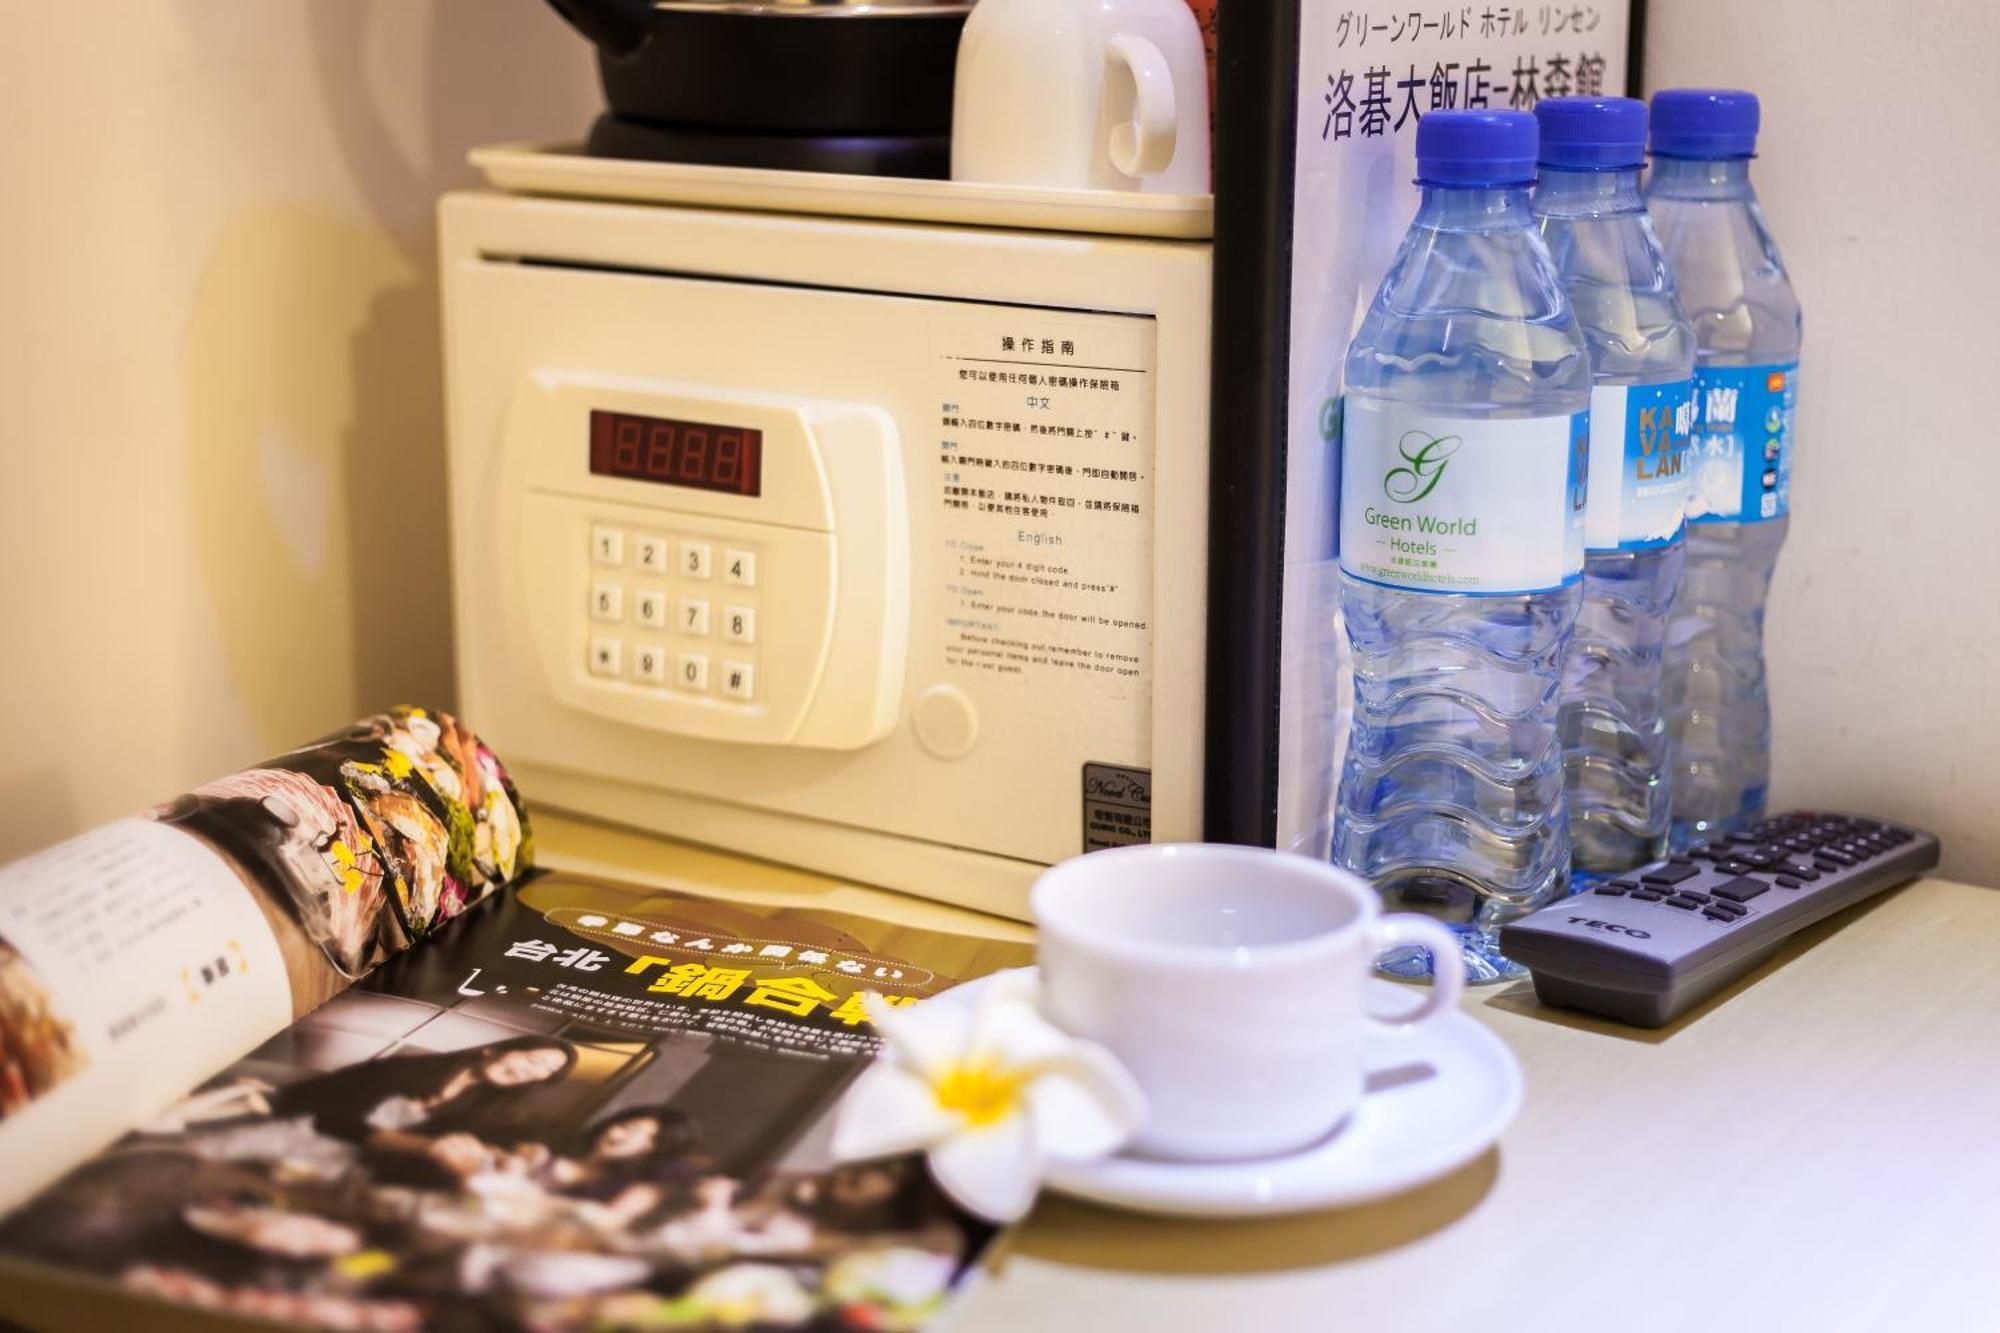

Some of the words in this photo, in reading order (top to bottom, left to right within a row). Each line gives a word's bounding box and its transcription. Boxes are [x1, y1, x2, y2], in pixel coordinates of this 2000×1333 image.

[1336, 7, 1472, 48] グリーンワールド
[1480, 7, 1528, 39] ホテル
[1026, 396, 1050, 409] 中文
[1364, 507, 1411, 531] Green
[1417, 515, 1476, 536] World
[1018, 531, 1063, 546] English
[1390, 537, 1437, 556] Hotels
[602, 538, 610, 555] 1
[643, 545, 654, 565] 2
[689, 551, 699, 571] 3
[731, 559, 741, 578] 4
[643, 600, 653, 618] 6
[687, 608, 698, 626] 7
[733, 616, 742, 635] 8
[643, 654, 652, 672] 9
[1567, 916, 1652, 939] TECO
[504, 939, 611, 972] 台北
